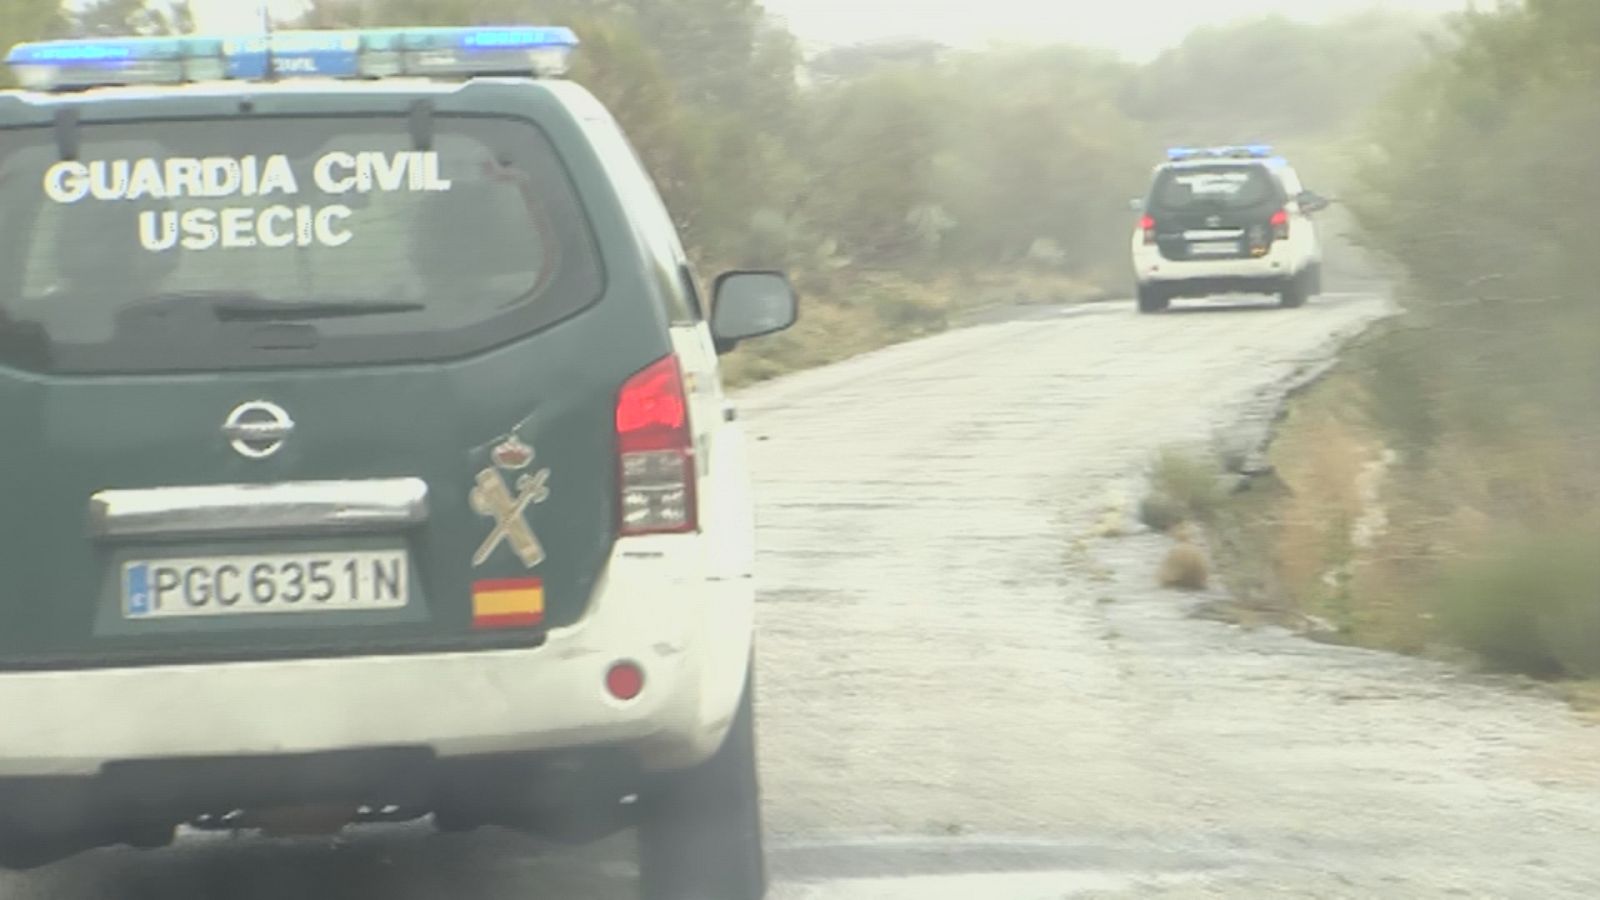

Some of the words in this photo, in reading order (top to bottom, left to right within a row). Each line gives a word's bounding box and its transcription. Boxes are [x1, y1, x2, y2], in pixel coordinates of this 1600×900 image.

[44, 154, 298, 203] GUARDIA
[314, 151, 451, 193] CIVIL
[139, 204, 353, 250] USECIC
